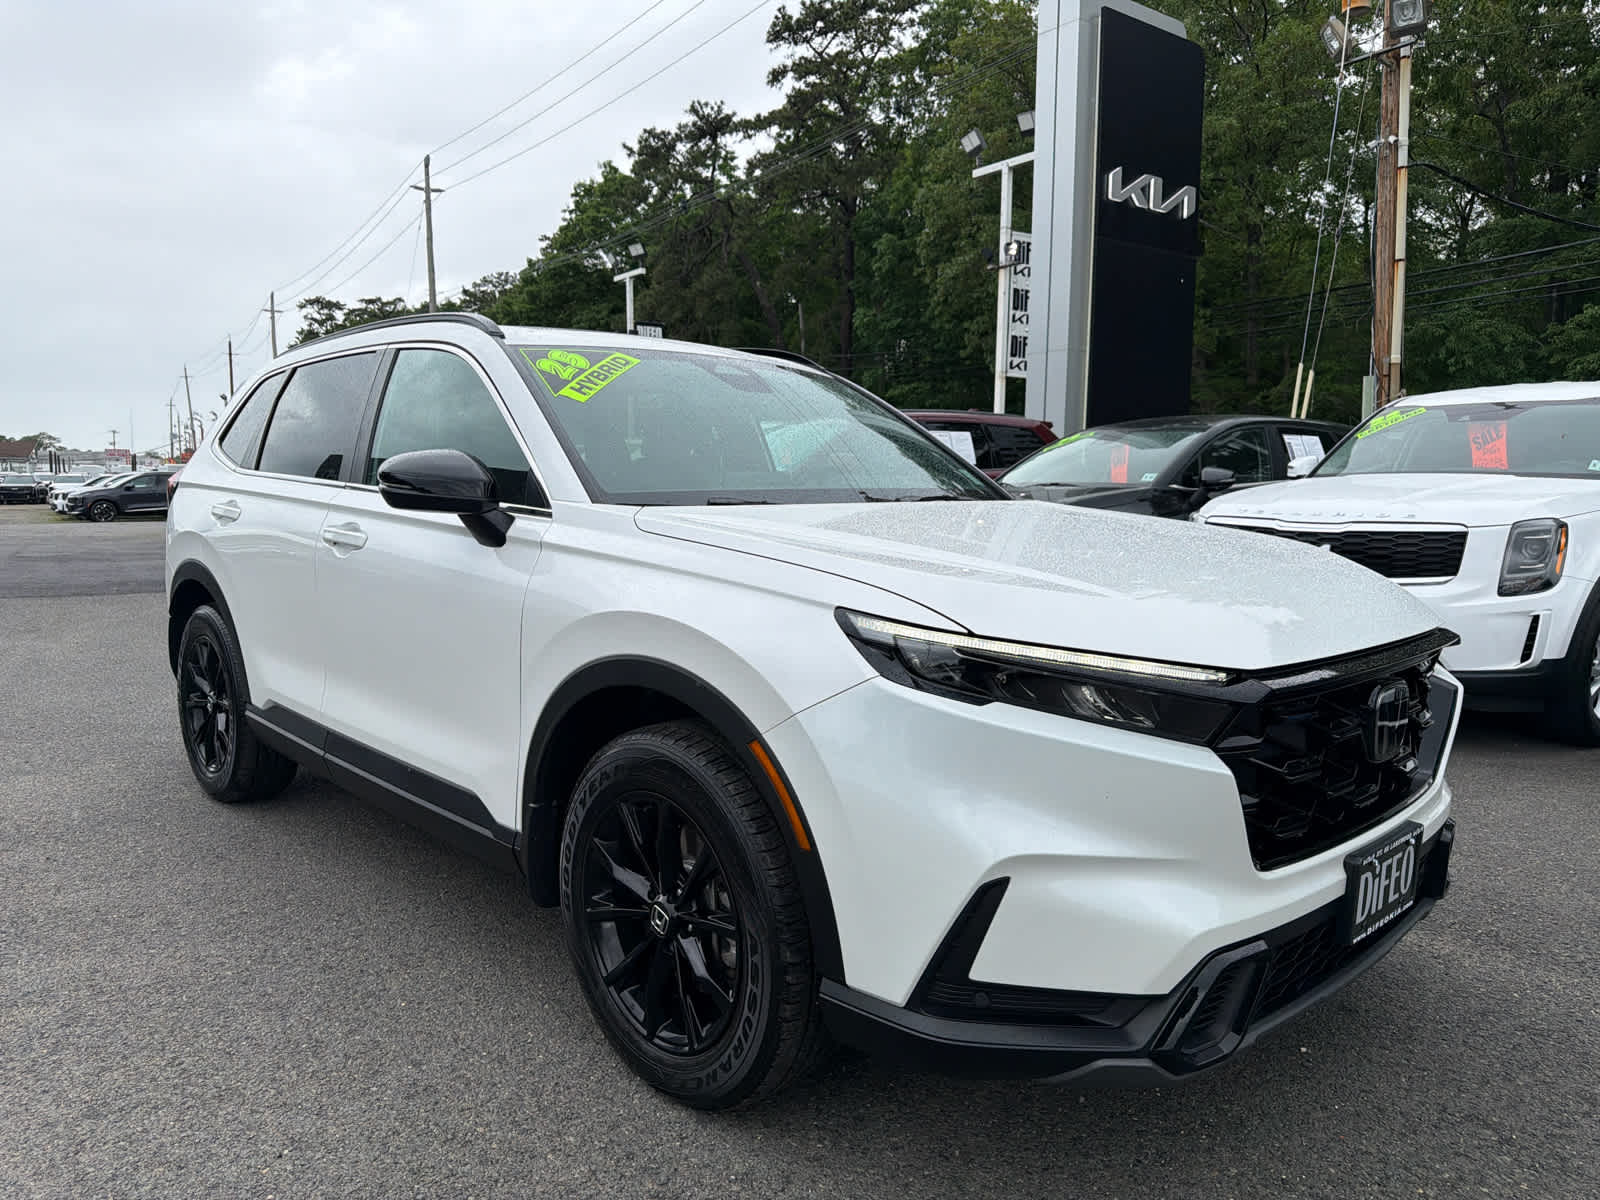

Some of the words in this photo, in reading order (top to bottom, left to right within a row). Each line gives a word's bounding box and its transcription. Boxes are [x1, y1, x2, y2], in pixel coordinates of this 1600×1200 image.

[1013, 240, 1031, 264] DiF
[1013, 265, 1031, 277] KI
[1012, 287, 1030, 312] DiF
[1012, 313, 1029, 325] KI
[1010, 335, 1028, 358] DiF
[569, 356, 631, 396] HYBRID
[1009, 360, 1027, 371] KI
[1471, 426, 1505, 450] SALE
[562, 761, 627, 913] GOODYEAR
[1355, 845, 1415, 925] DiFEO
